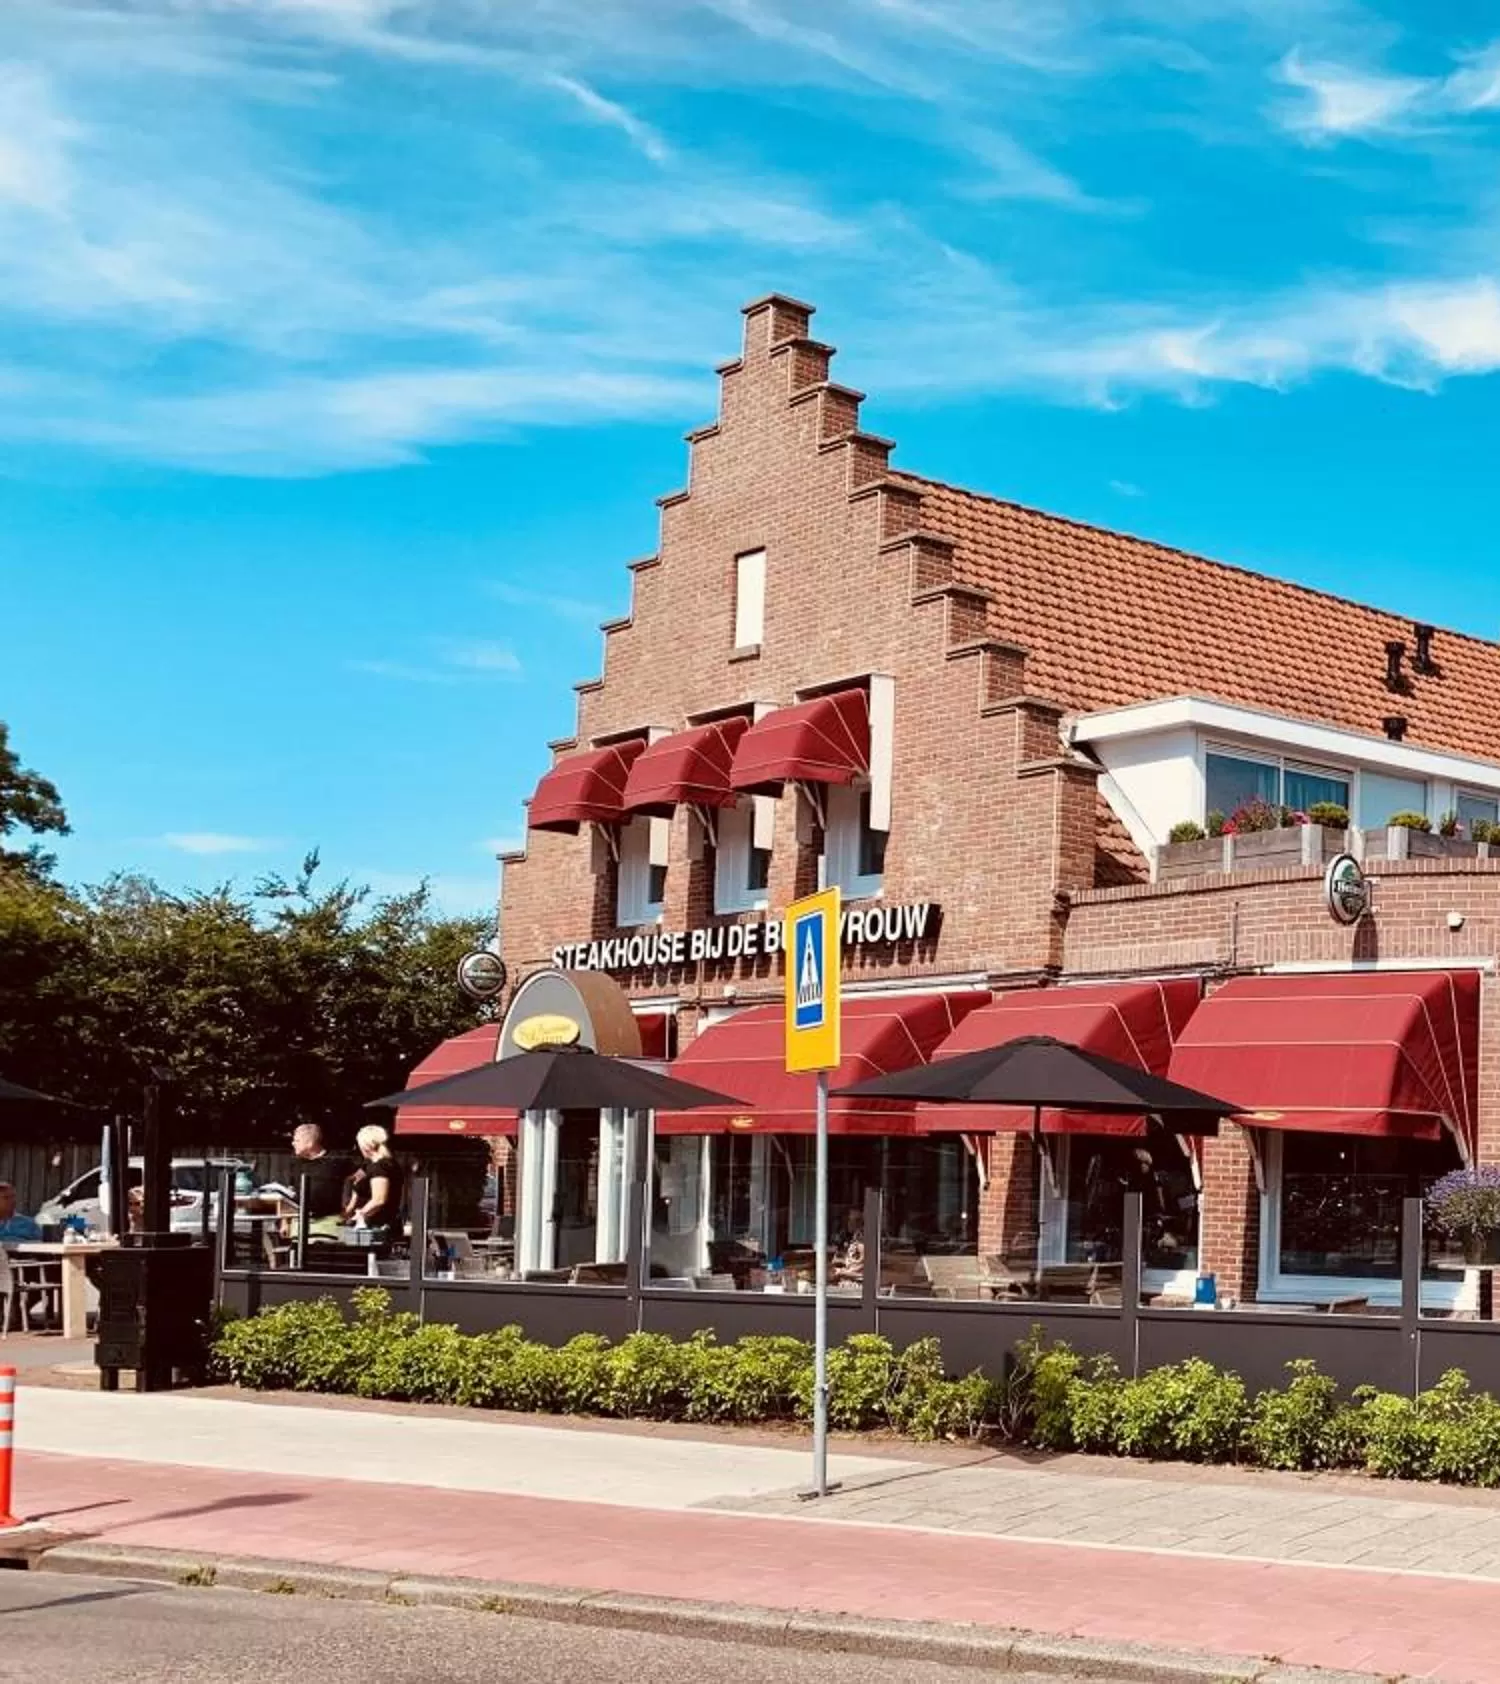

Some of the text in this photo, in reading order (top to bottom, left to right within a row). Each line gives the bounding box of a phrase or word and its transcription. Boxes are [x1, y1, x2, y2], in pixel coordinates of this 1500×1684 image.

[551, 903, 930, 971] STEAKHOUSE BIJ DE BROUW
